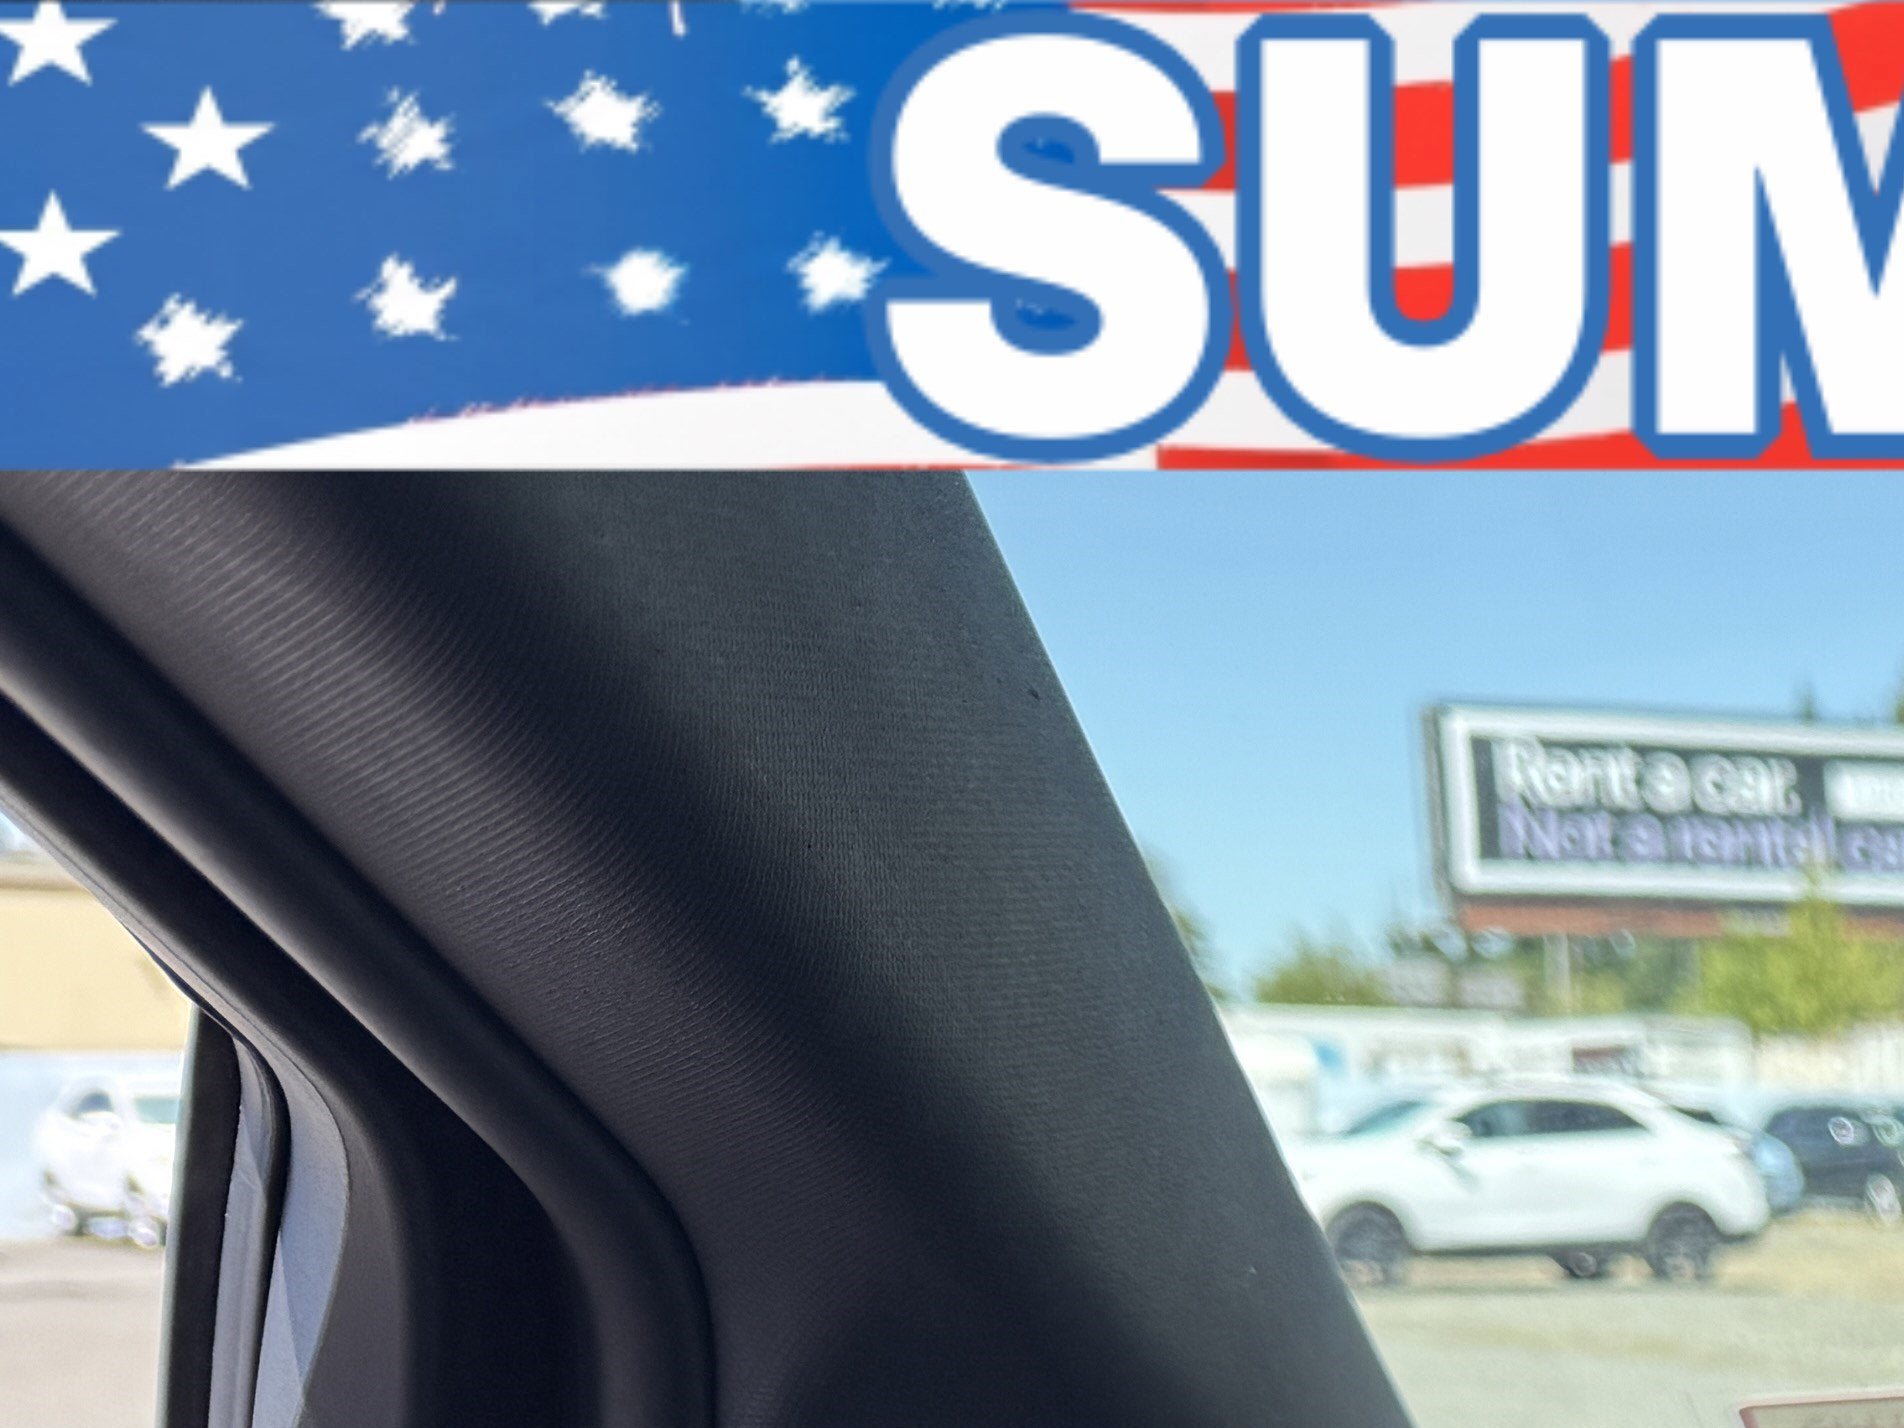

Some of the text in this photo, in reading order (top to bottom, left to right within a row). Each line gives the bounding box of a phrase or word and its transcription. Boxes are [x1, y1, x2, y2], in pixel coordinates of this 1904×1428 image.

[1492, 736, 1640, 812] Rent
[1642, 752, 1692, 812] a
[1693, 753, 1800, 814] car.
[1498, 802, 1613, 860] Not
[1617, 813, 1668, 864] a
